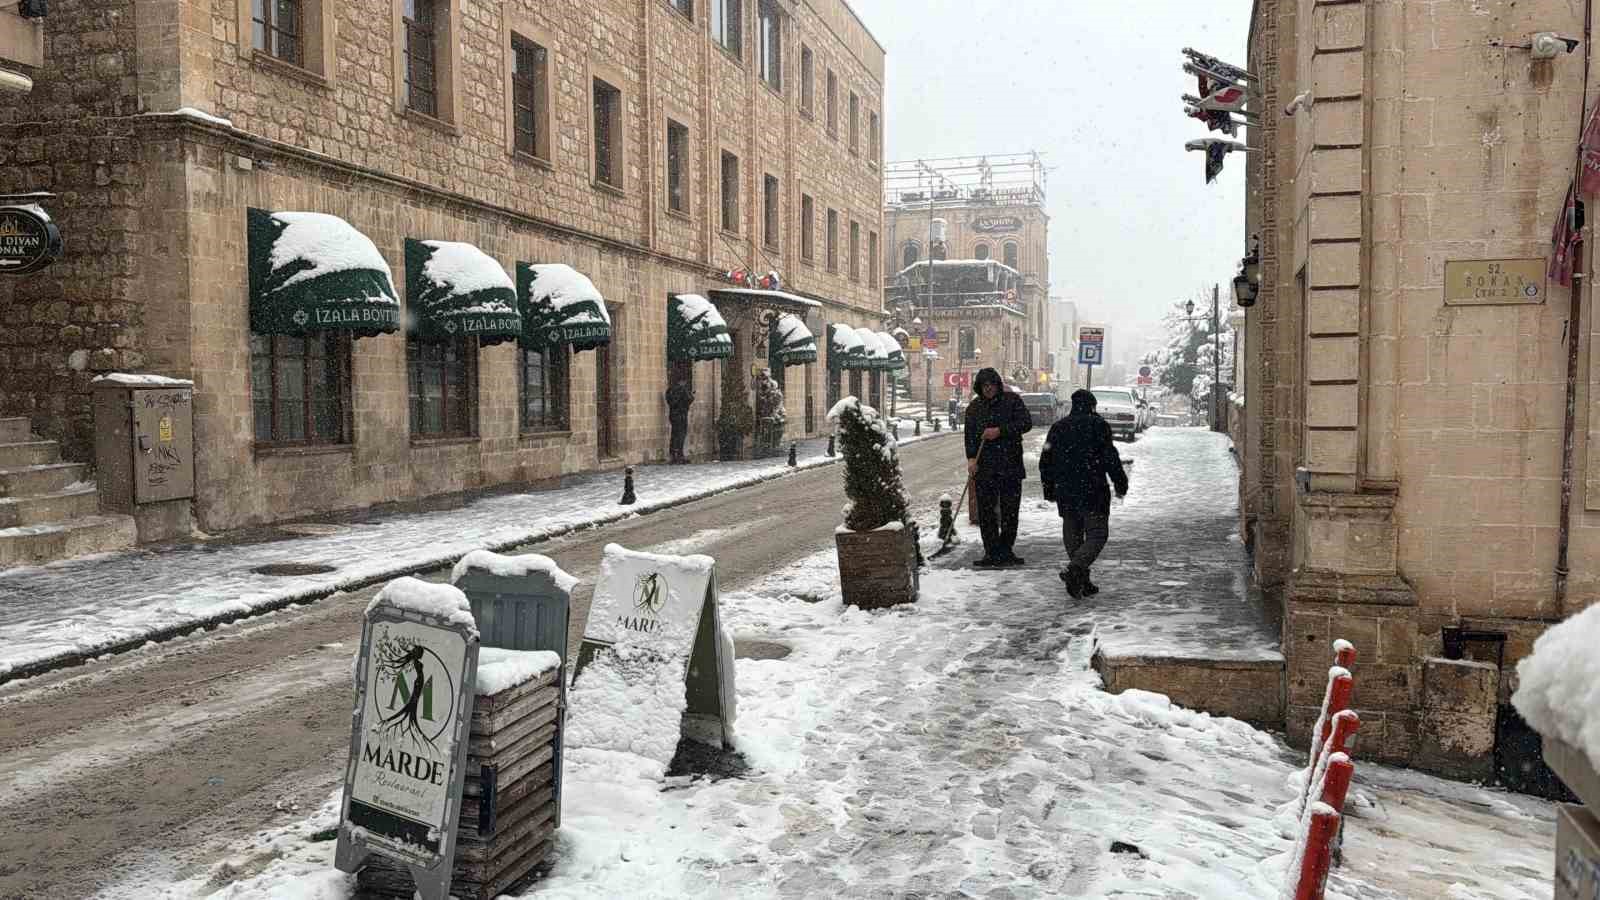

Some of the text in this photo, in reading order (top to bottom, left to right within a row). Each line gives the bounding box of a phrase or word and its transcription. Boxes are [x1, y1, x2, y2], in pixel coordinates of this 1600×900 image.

[6, 236, 40, 248] DIVAN
[362, 741, 445, 787] MARDE
[373, 770, 427, 798] Restaurant
